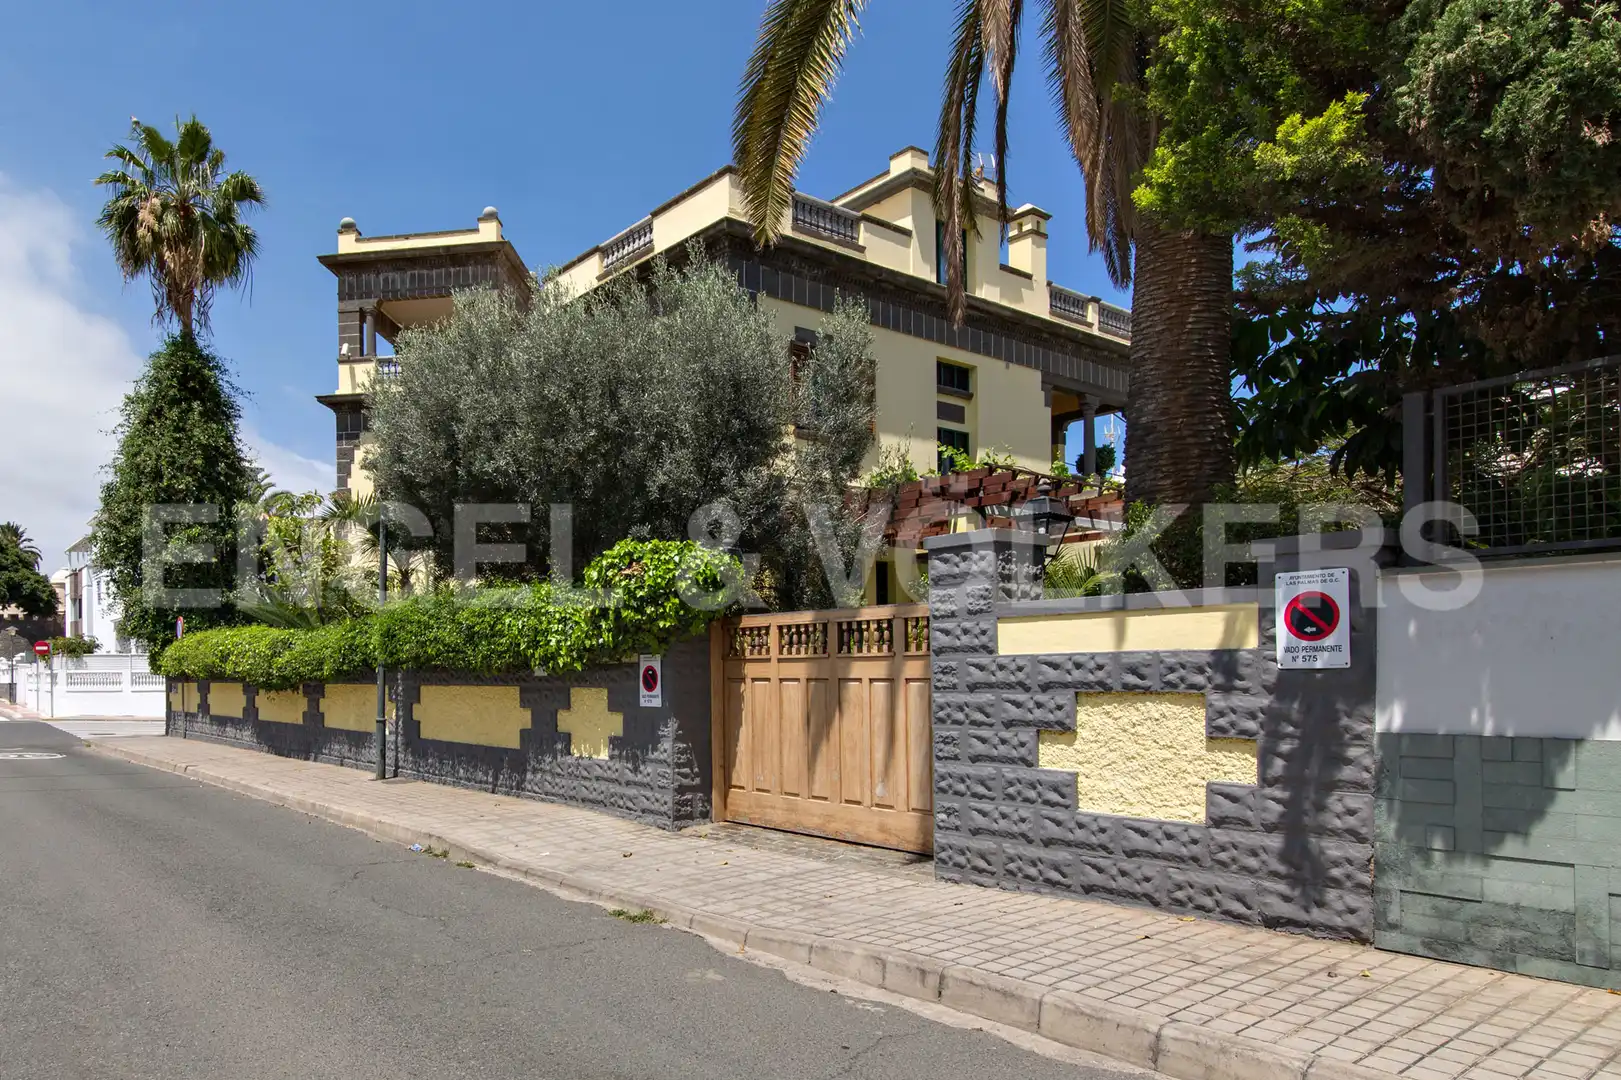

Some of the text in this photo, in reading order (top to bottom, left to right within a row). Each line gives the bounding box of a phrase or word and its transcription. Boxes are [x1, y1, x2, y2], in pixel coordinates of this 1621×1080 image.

[1283, 644, 1343, 653] VADO PERMANENTE
[1301, 655, 1318, 663] 575
